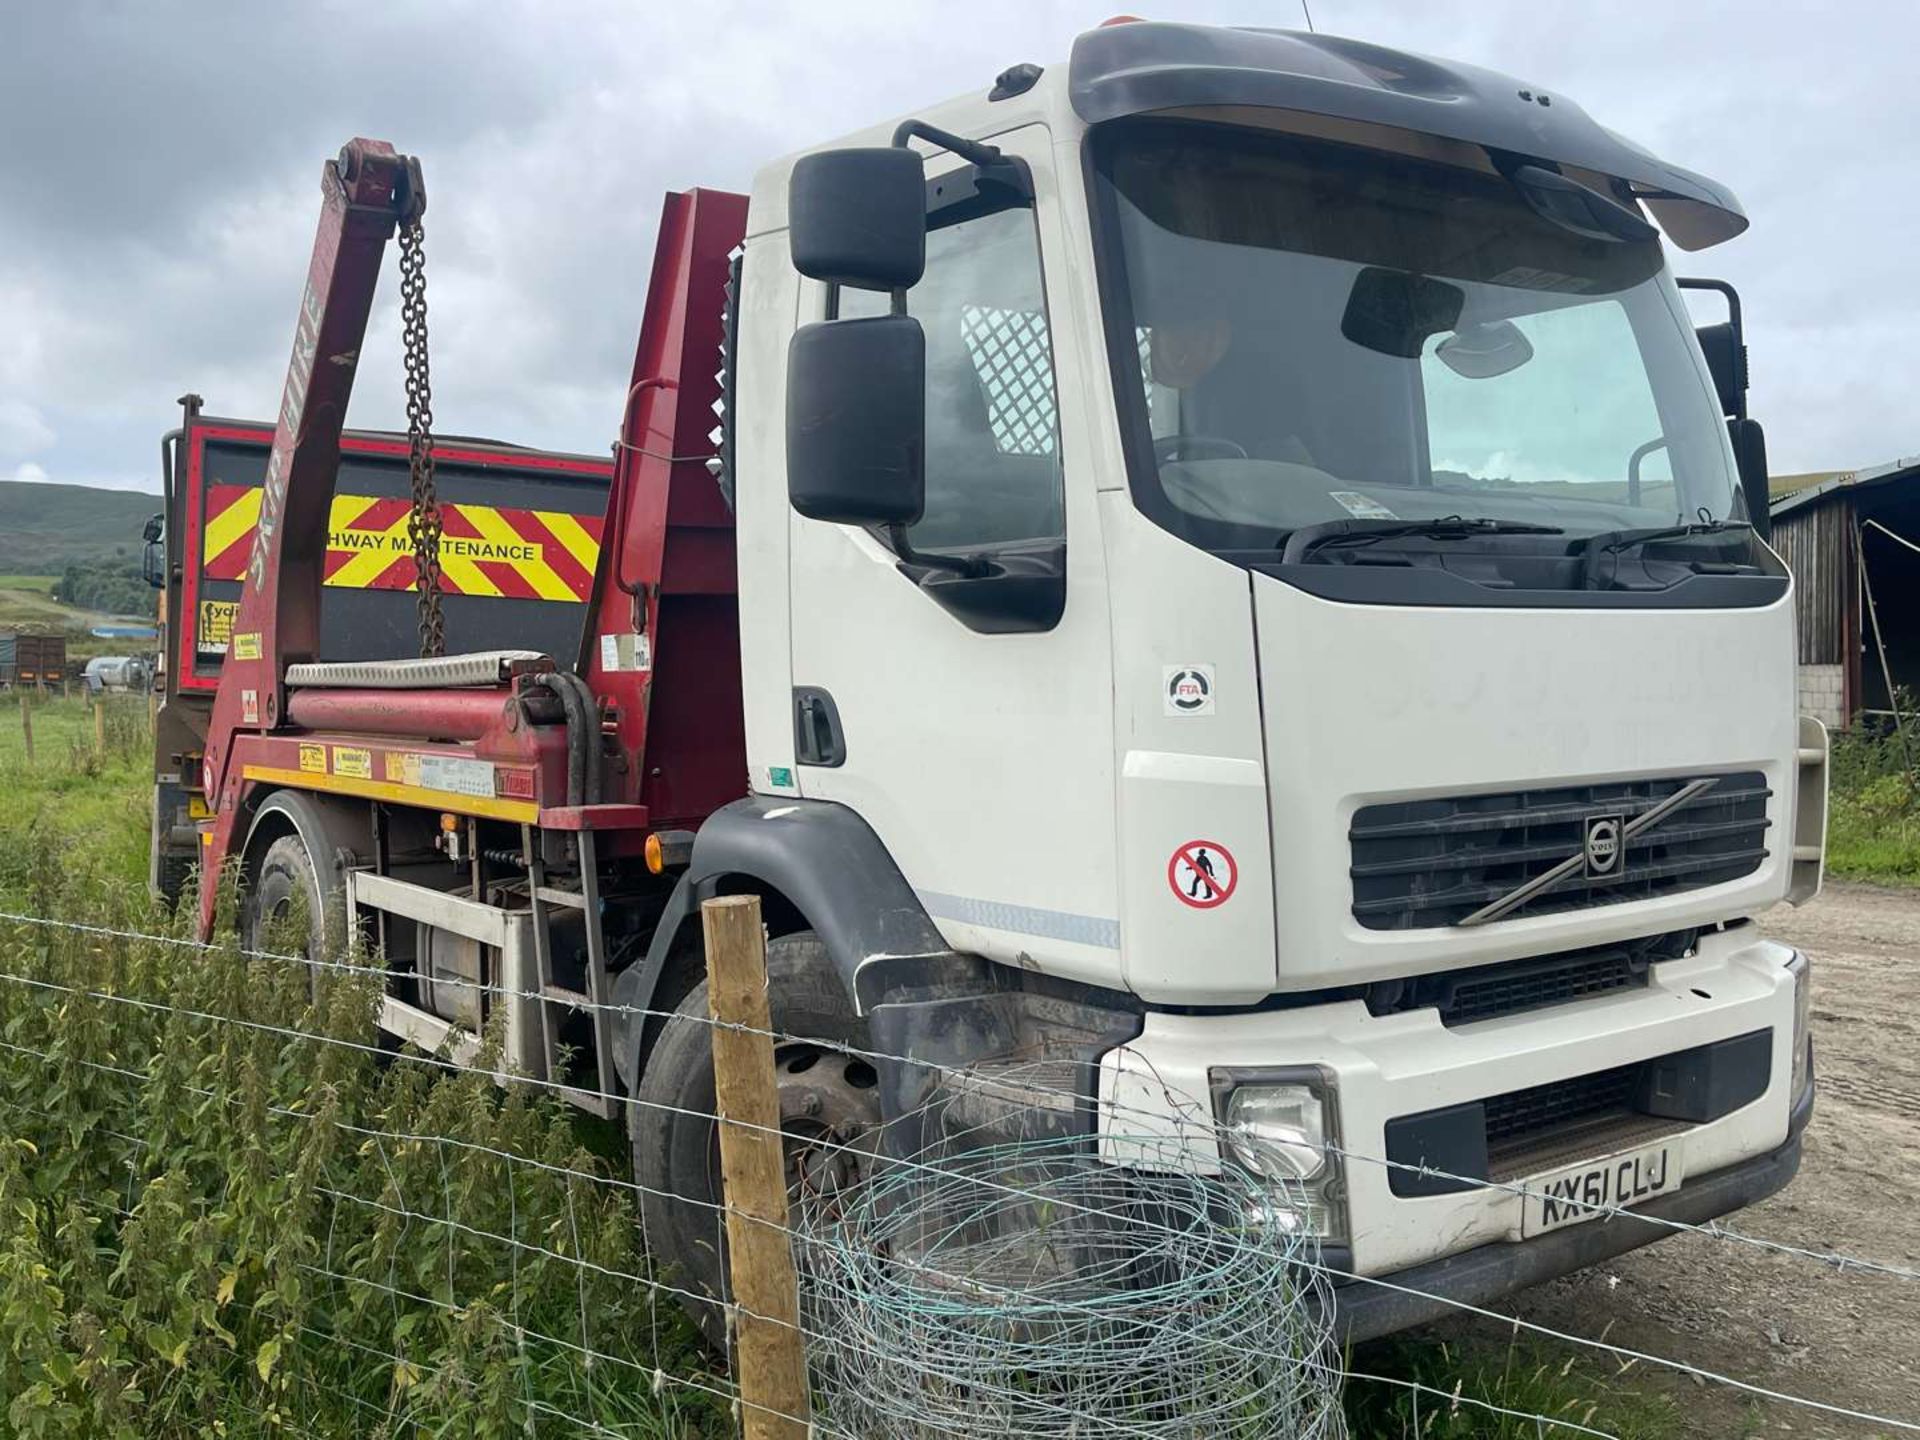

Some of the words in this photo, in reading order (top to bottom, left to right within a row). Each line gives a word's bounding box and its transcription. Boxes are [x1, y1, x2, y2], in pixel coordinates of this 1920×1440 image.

[391, 536, 534, 560] MATENANCE
[1179, 684, 1200, 695] FTA
[1542, 1167, 1609, 1226] KX61
[1616, 1149, 1667, 1202] CLJ
